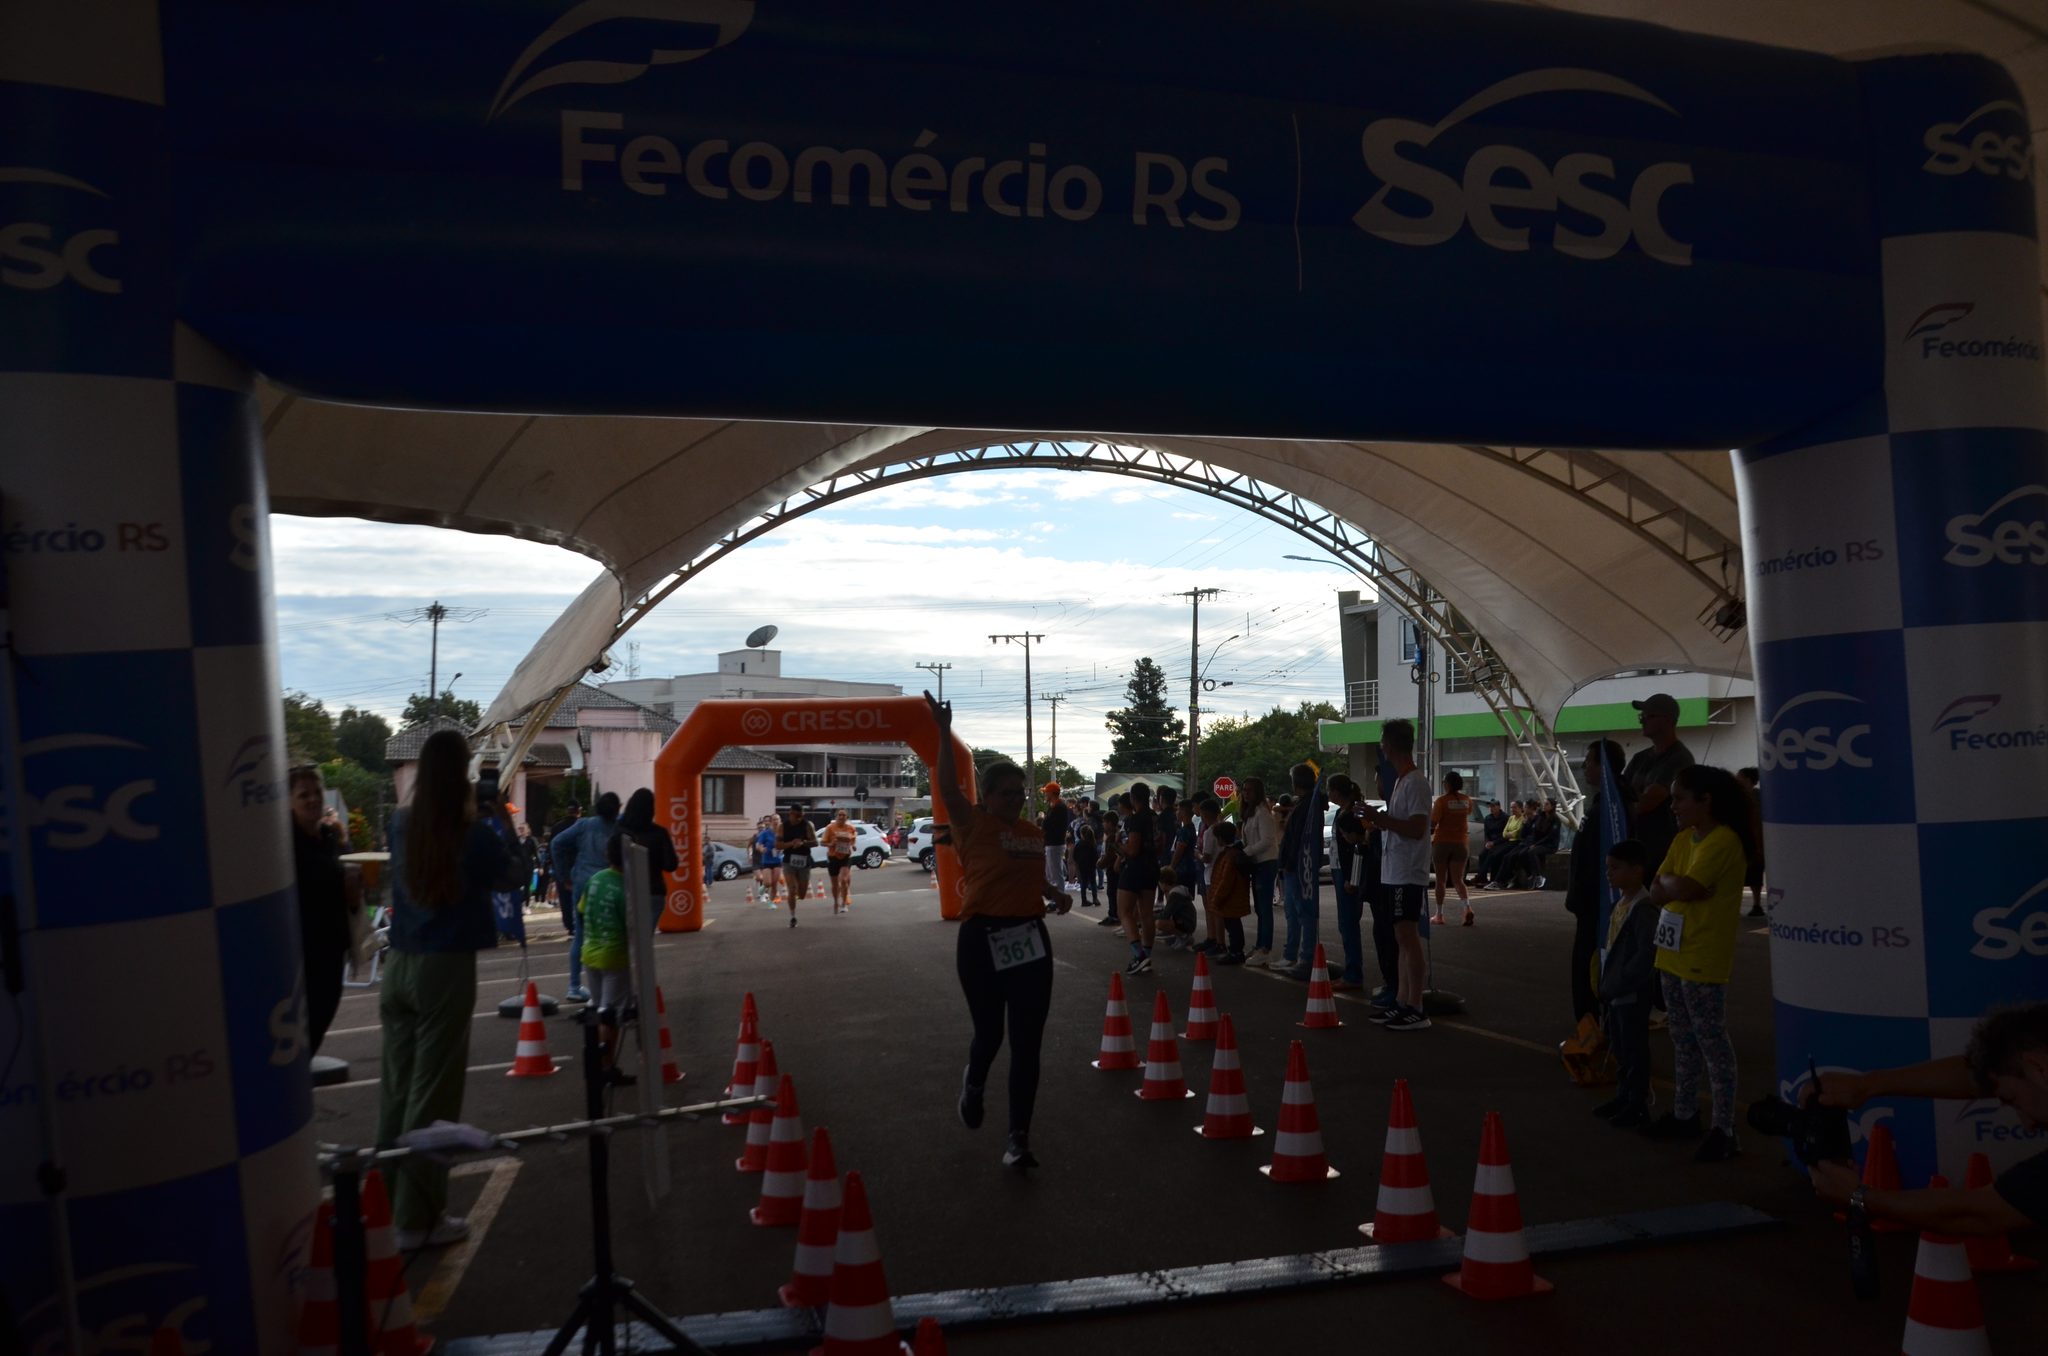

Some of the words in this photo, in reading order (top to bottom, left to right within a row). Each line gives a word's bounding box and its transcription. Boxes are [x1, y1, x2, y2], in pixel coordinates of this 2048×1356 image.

[1921, 122, 2033, 181] Ses
[560, 109, 1103, 221] Fecomércio
[1131, 151, 1242, 232] RS
[1351, 116, 1695, 266] Sesc
[0, 222, 124, 295] sc
[2, 521, 106, 553] ércio
[117, 522, 170, 552] RS
[1942, 513, 2048, 567] Ses
[1758, 546, 1838, 576] omércio
[1845, 539, 1884, 563] RS
[781, 708, 892, 733] CRESOL
[1950, 724, 2048, 751] Fecomé
[1215, 783, 1233, 792] PARE
[670, 788, 690, 883] CRESOL
[998, 936, 1036, 965] 361
[1656, 924, 1676, 947] 93
[1771, 918, 1864, 946] ecomércio
[1871, 926, 1911, 948] RS
[1969, 906, 2048, 960] Se
